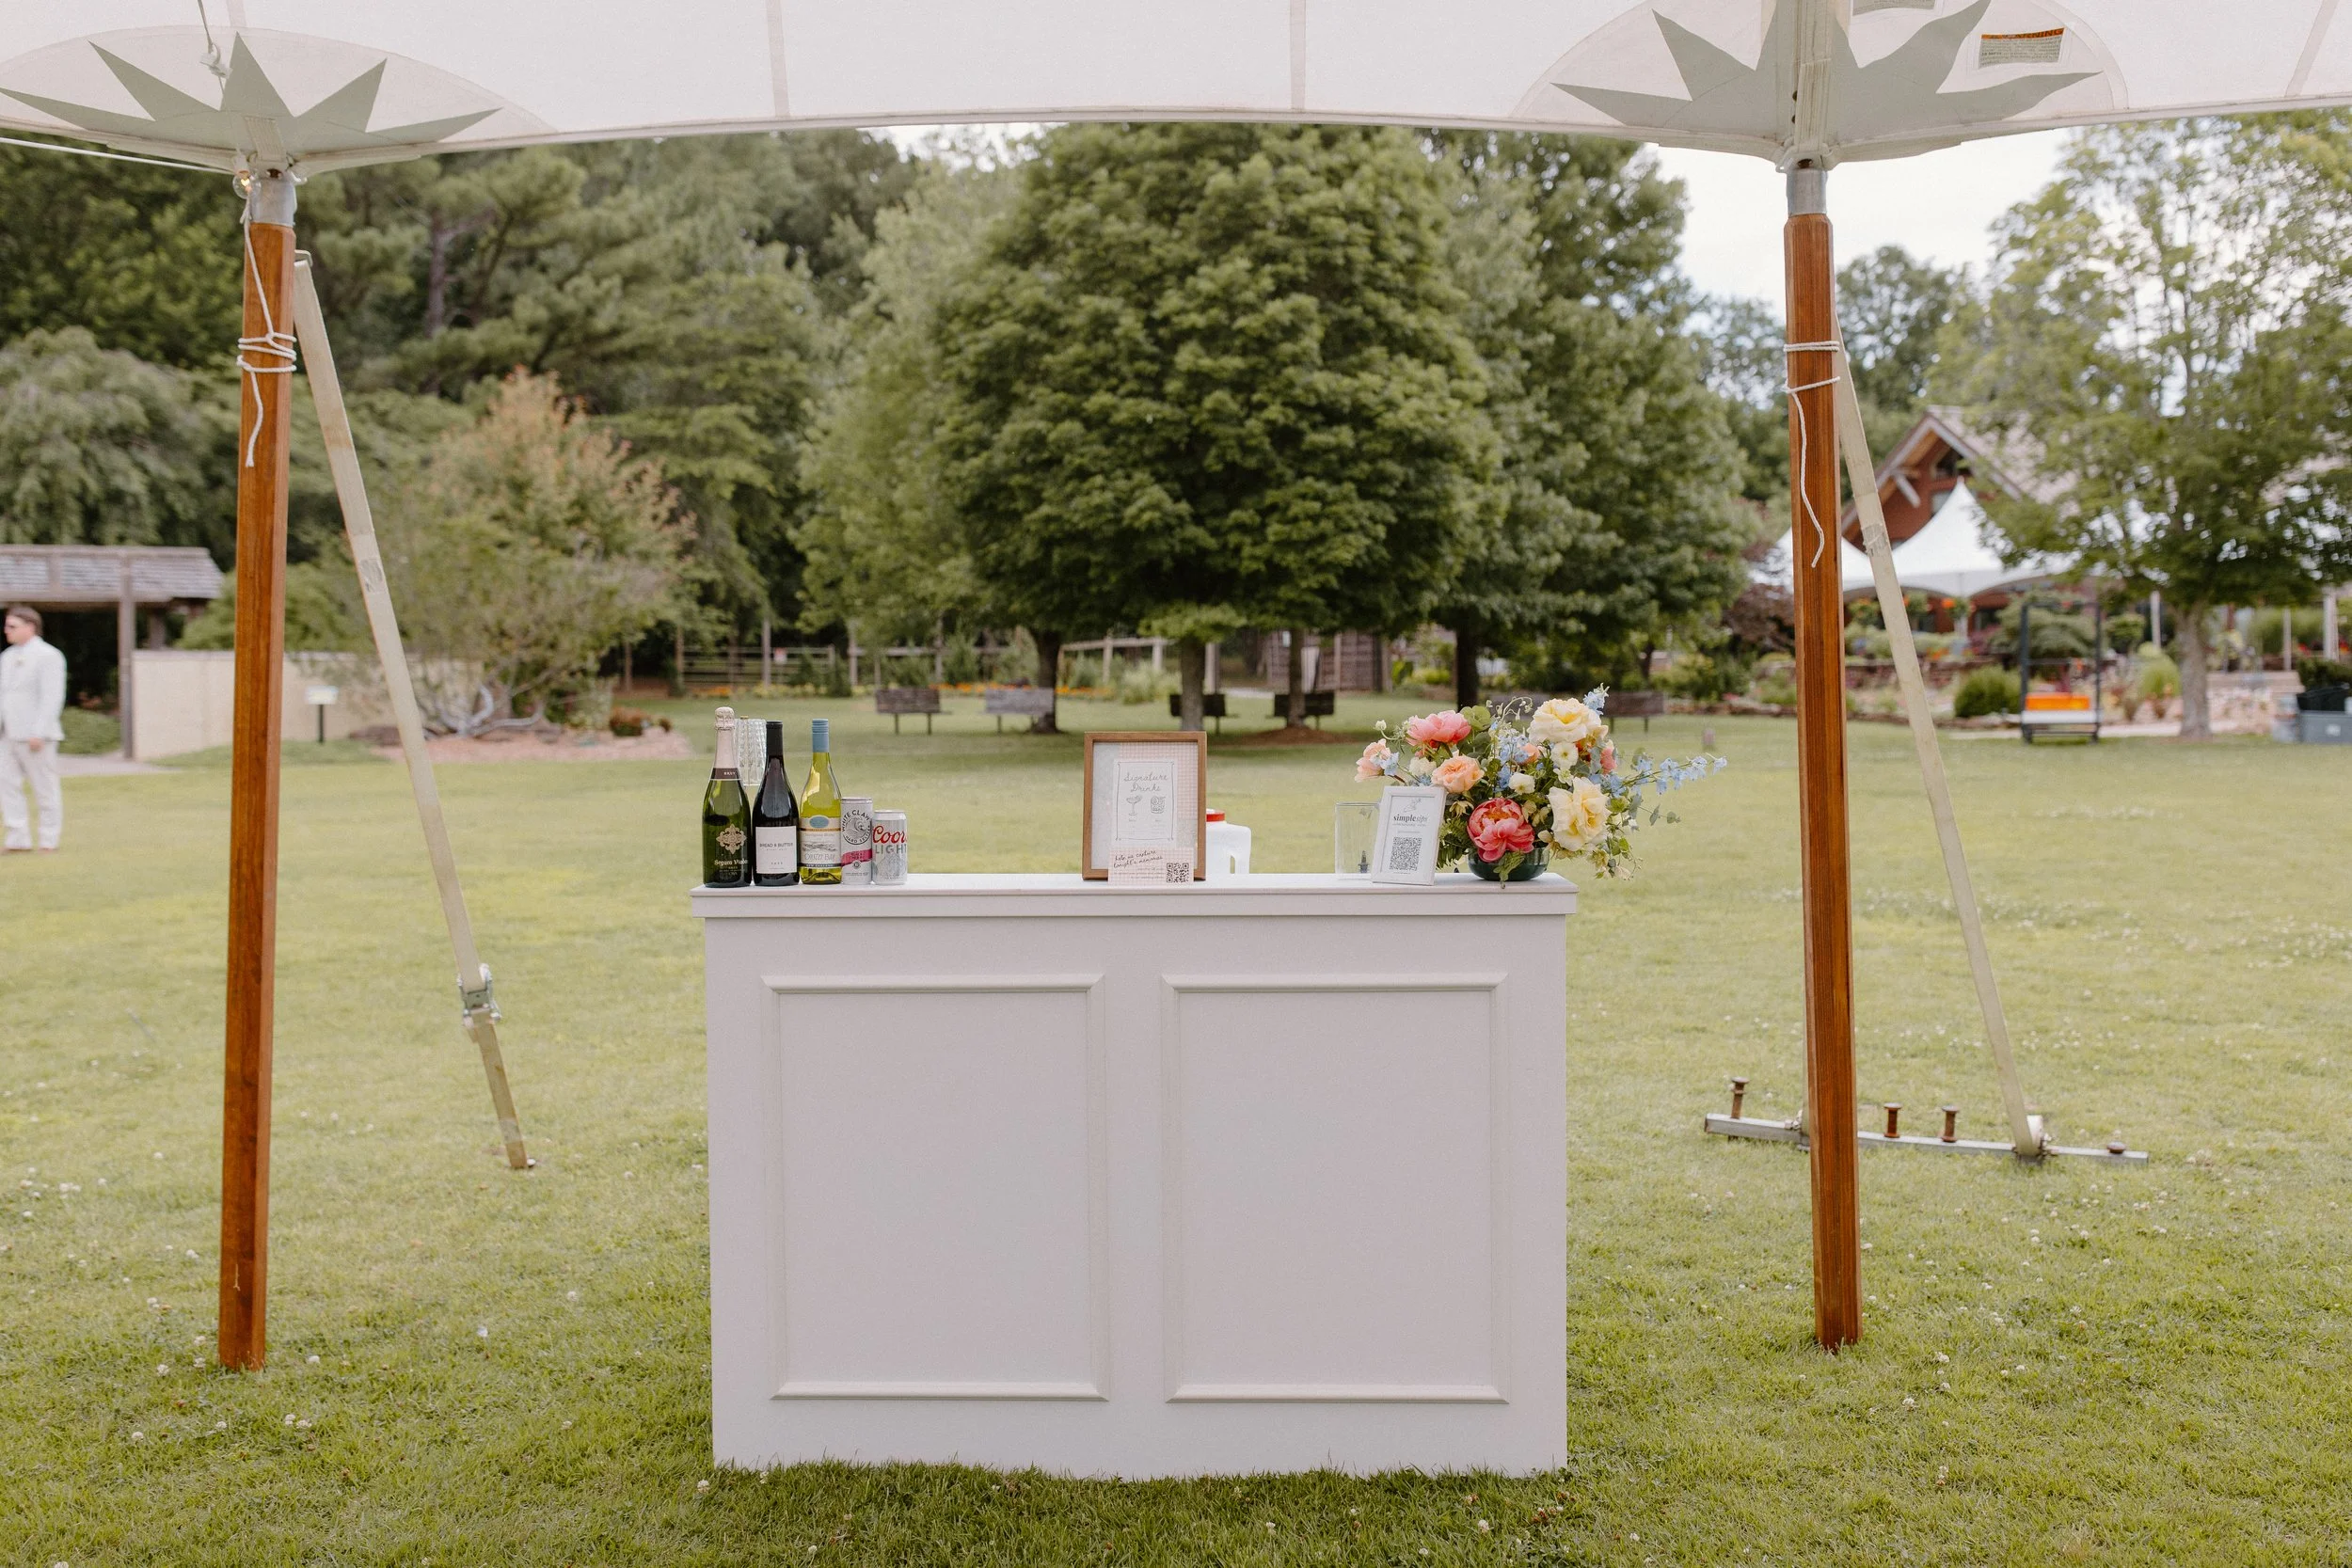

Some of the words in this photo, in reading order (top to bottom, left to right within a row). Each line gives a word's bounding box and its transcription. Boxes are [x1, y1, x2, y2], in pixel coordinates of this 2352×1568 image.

[1123, 771, 1168, 783] Signature
[1130, 783, 1160, 792] Drinks
[841, 812, 851, 832] WHITE
[851, 810, 870, 821] CLAW
[872, 825, 908, 844] Coor
[845, 835, 858, 844] HARD
[1136, 849, 1156, 858] capture
[714, 859, 733, 867] Segura
